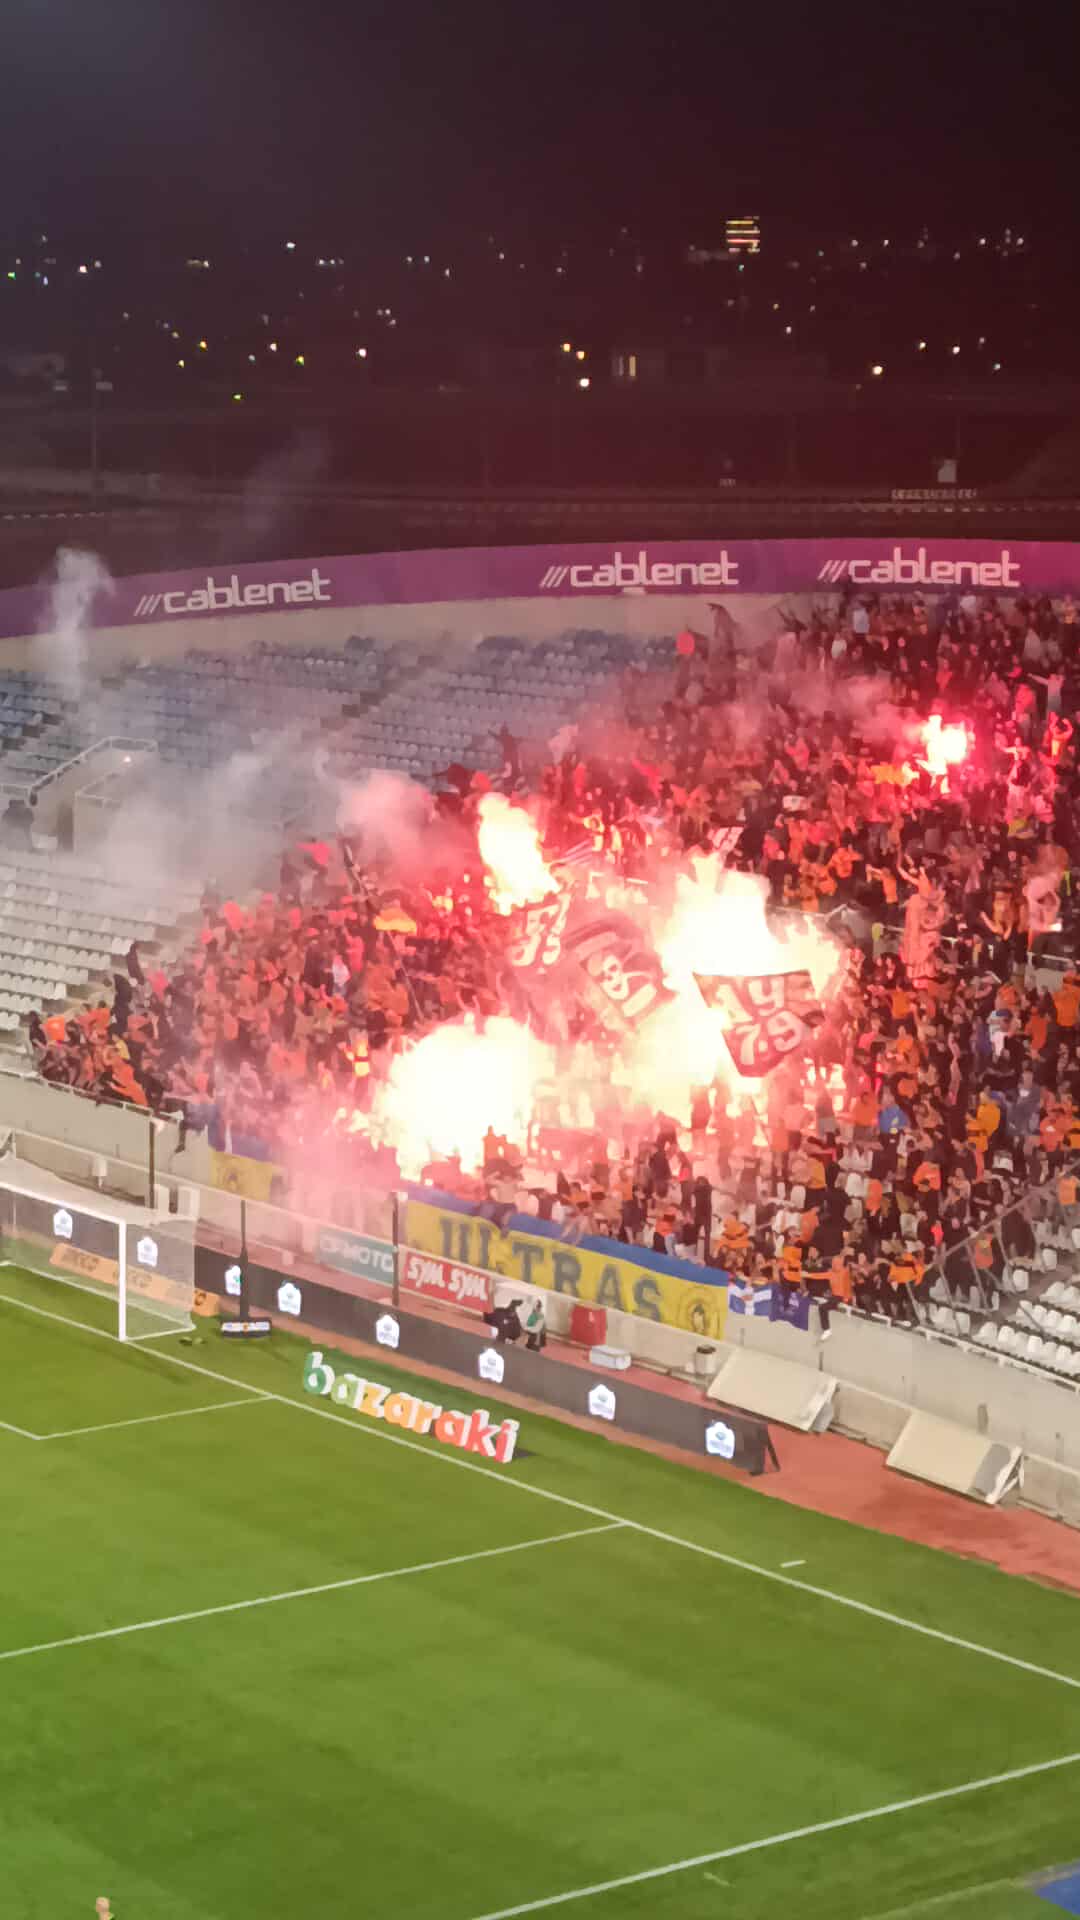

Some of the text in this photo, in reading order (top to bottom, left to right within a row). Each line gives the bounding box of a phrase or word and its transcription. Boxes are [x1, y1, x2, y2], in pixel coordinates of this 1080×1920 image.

[570, 549, 739, 588] cablenet
[847, 546, 1021, 588] cablenet
[163, 567, 332, 614] cablenet
[407, 1256, 489, 1301] SYM SYM
[439, 1214, 663, 1323] ULTRAS
[303, 1351, 520, 1464] bazaraki
